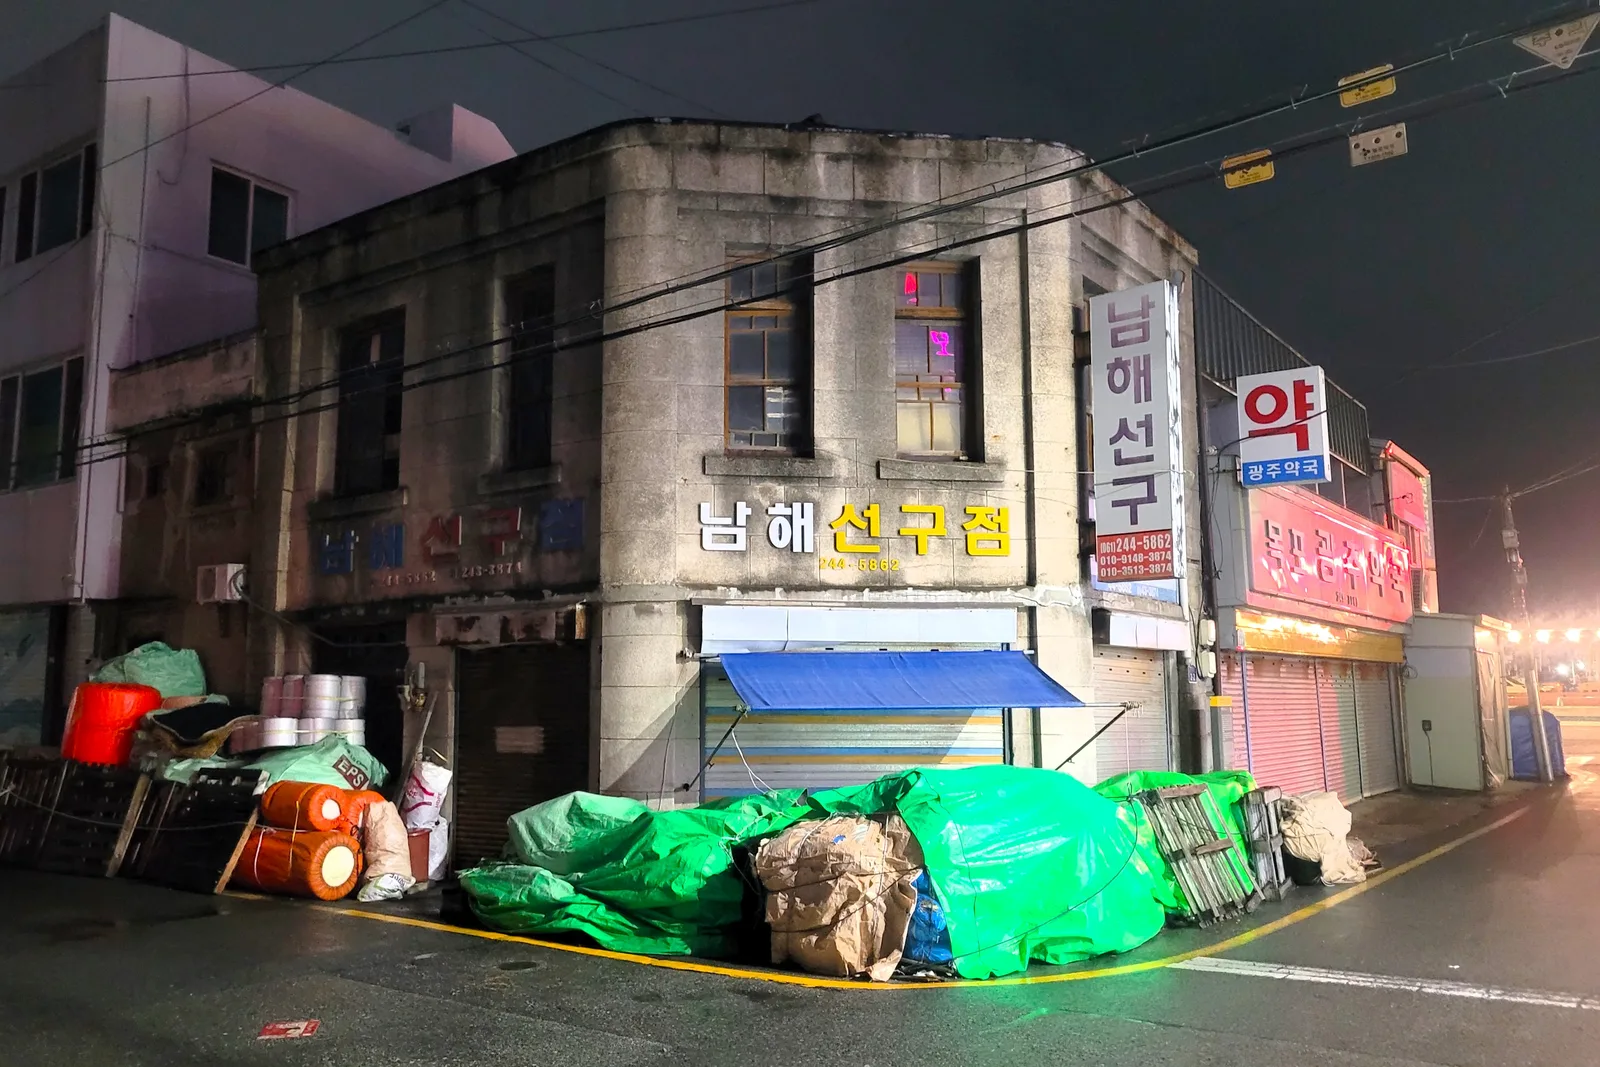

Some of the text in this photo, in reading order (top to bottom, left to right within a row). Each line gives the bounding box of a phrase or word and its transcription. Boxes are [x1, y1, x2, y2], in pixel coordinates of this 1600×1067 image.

[1106, 294, 1158, 526] 남해선구
[1244, 379, 1315, 451] 약
[1248, 459, 1319, 481] 광주약국
[699, 501, 1012, 556] 남해선구점
[818, 556, 900, 572] 244-5862
[1100, 550, 1172, 566] 010-9148-3874
[1100, 563, 1173, 578] 010-3513-3874
[337, 759, 365, 788] EPS
